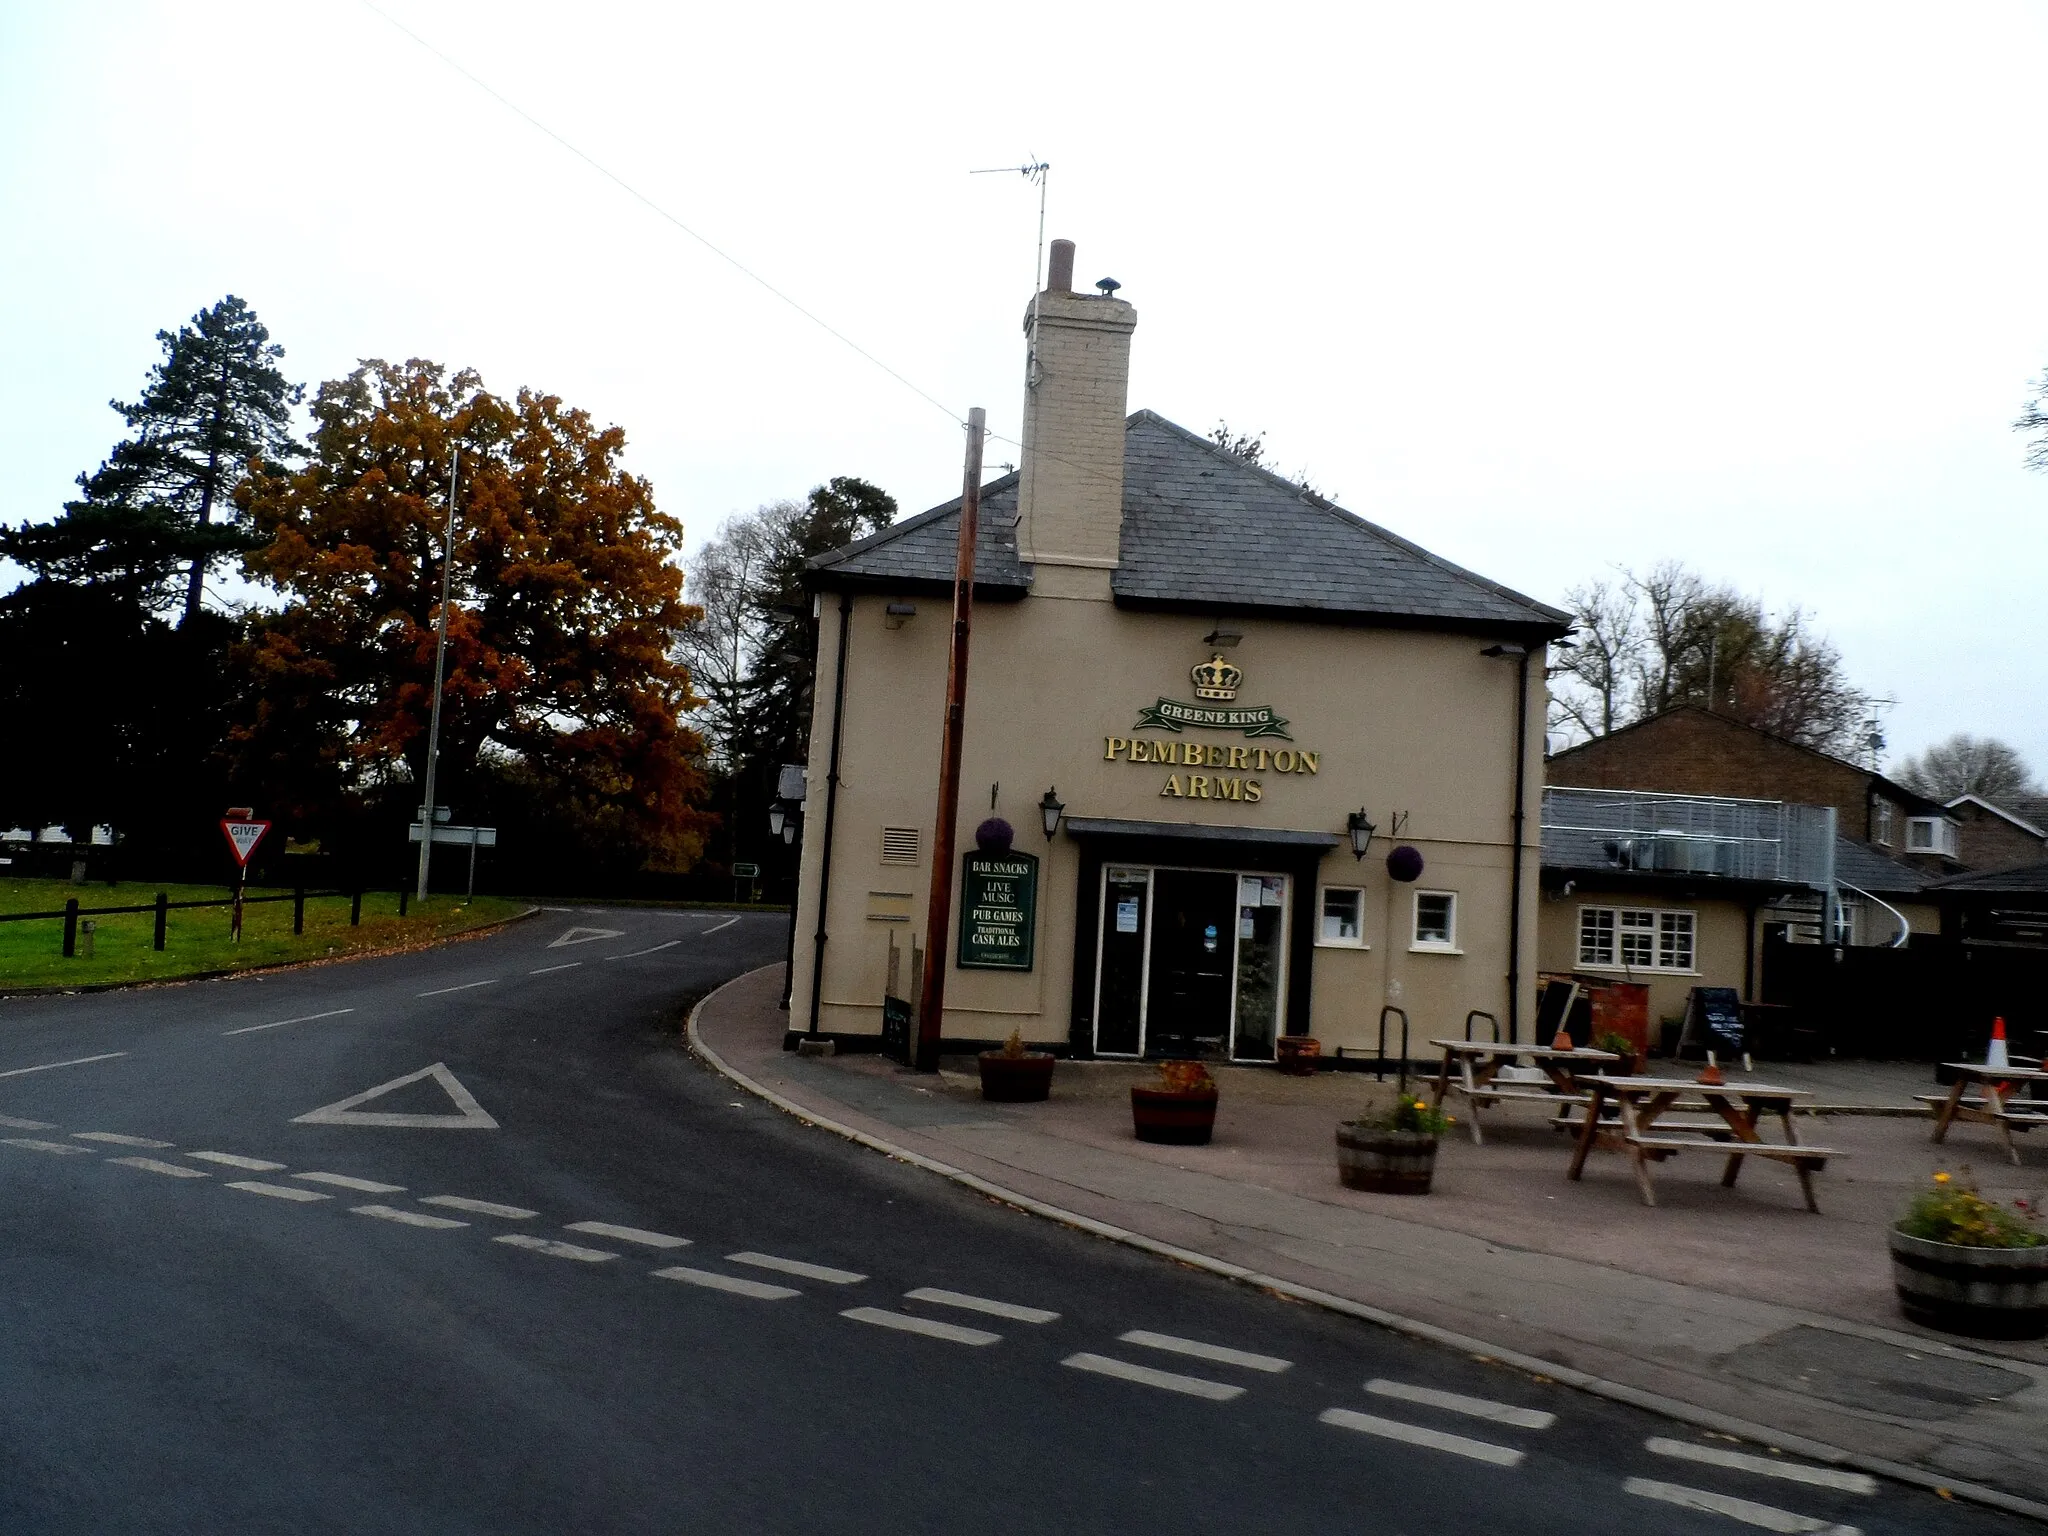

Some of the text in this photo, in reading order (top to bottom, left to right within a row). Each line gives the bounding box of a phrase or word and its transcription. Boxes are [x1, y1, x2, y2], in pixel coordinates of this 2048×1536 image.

[1160, 704, 1269, 723] GREENE KING
[1104, 737, 1321, 774] PEMBERTON
[1160, 774, 1263, 802] ARMS
[231, 826, 258, 836] GIVE
[973, 861, 1028, 875] BAR SNACKS
[987, 882, 1011, 892] LIVE
[982, 892, 1015, 903] MUSIC
[973, 909, 1023, 922] PUB GAMES
[977, 926, 1015, 935] TRADITIONAL
[972, 934, 1020, 946] CASK ALES
